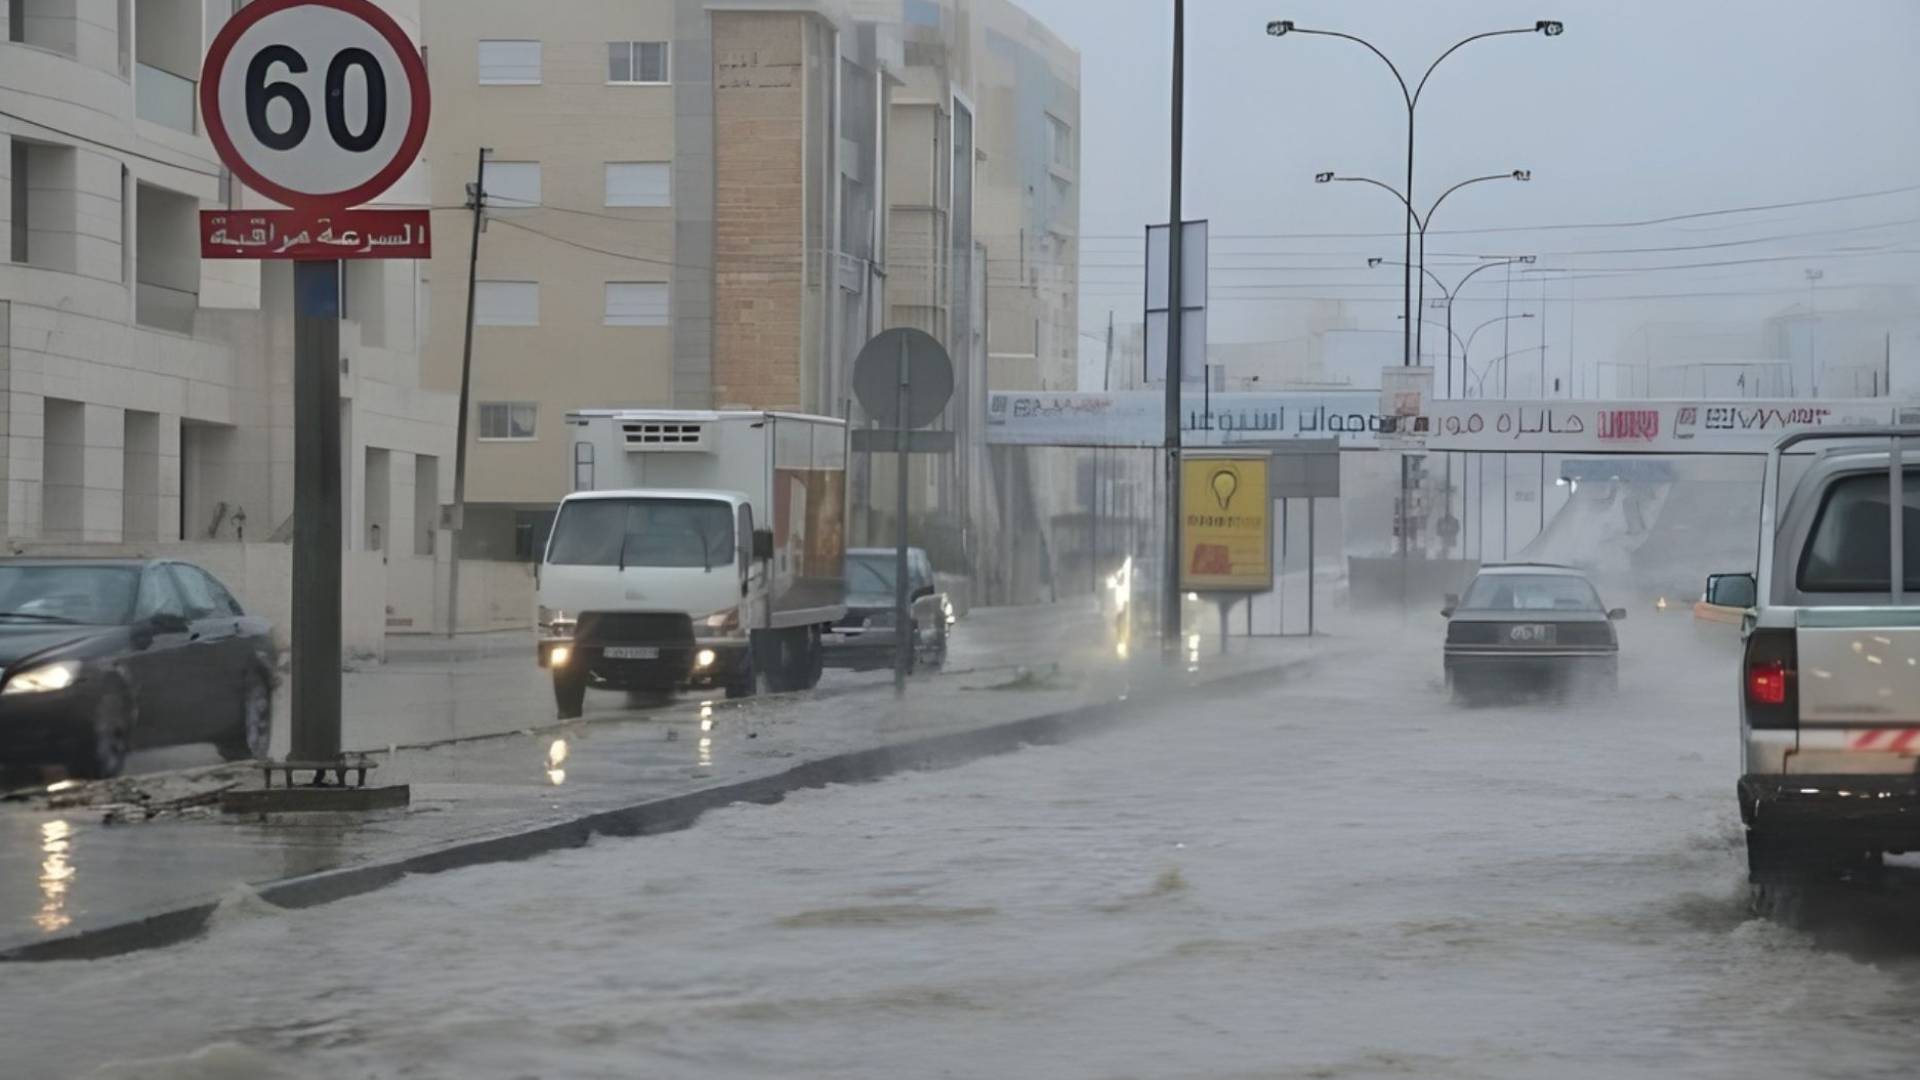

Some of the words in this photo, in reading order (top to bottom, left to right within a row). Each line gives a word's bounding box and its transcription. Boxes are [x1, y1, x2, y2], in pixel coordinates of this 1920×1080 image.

[245, 44, 387, 153] 60
[209, 216, 311, 254] مراقبة
[316, 217, 425, 253] السرعة
